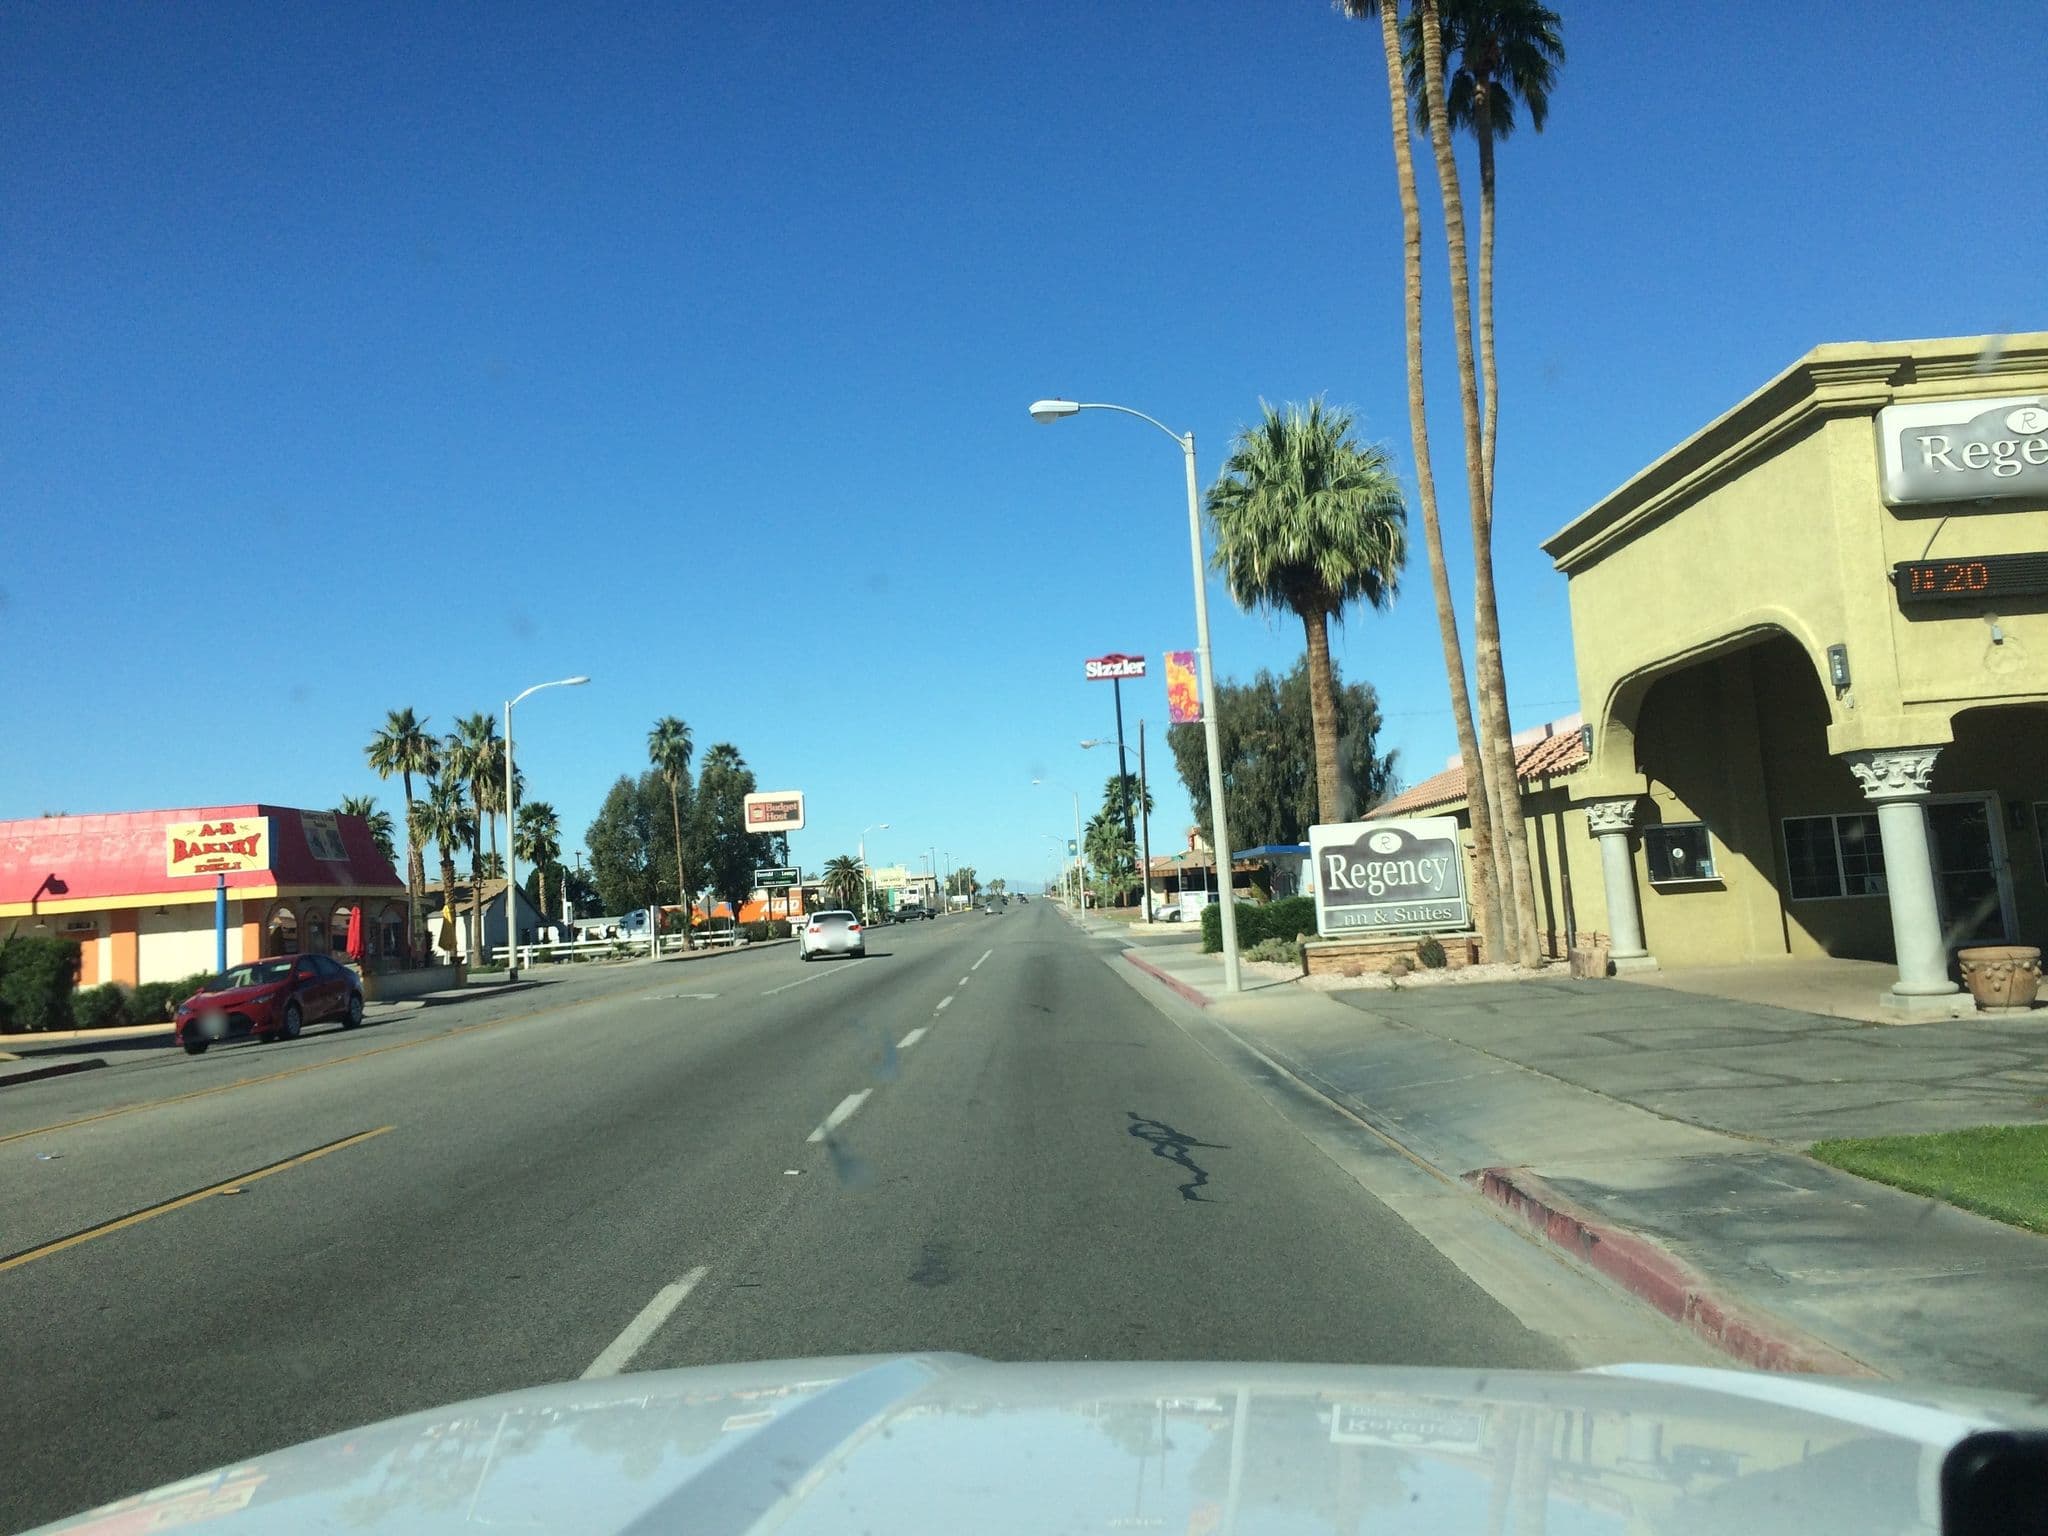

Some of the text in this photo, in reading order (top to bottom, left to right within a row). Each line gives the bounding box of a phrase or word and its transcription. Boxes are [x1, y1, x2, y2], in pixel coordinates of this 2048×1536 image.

[2021, 412, 2037, 431] R
[1085, 660, 1146, 677] Sizzler
[766, 802, 797, 812] Budget
[766, 812, 788, 821] Host
[198, 822, 237, 837] A-R
[172, 833, 261, 864] BAKERY
[194, 862, 241, 873] DELI
[1325, 854, 1449, 897] Regency
[1339, 905, 1453, 926] nn & Suites
